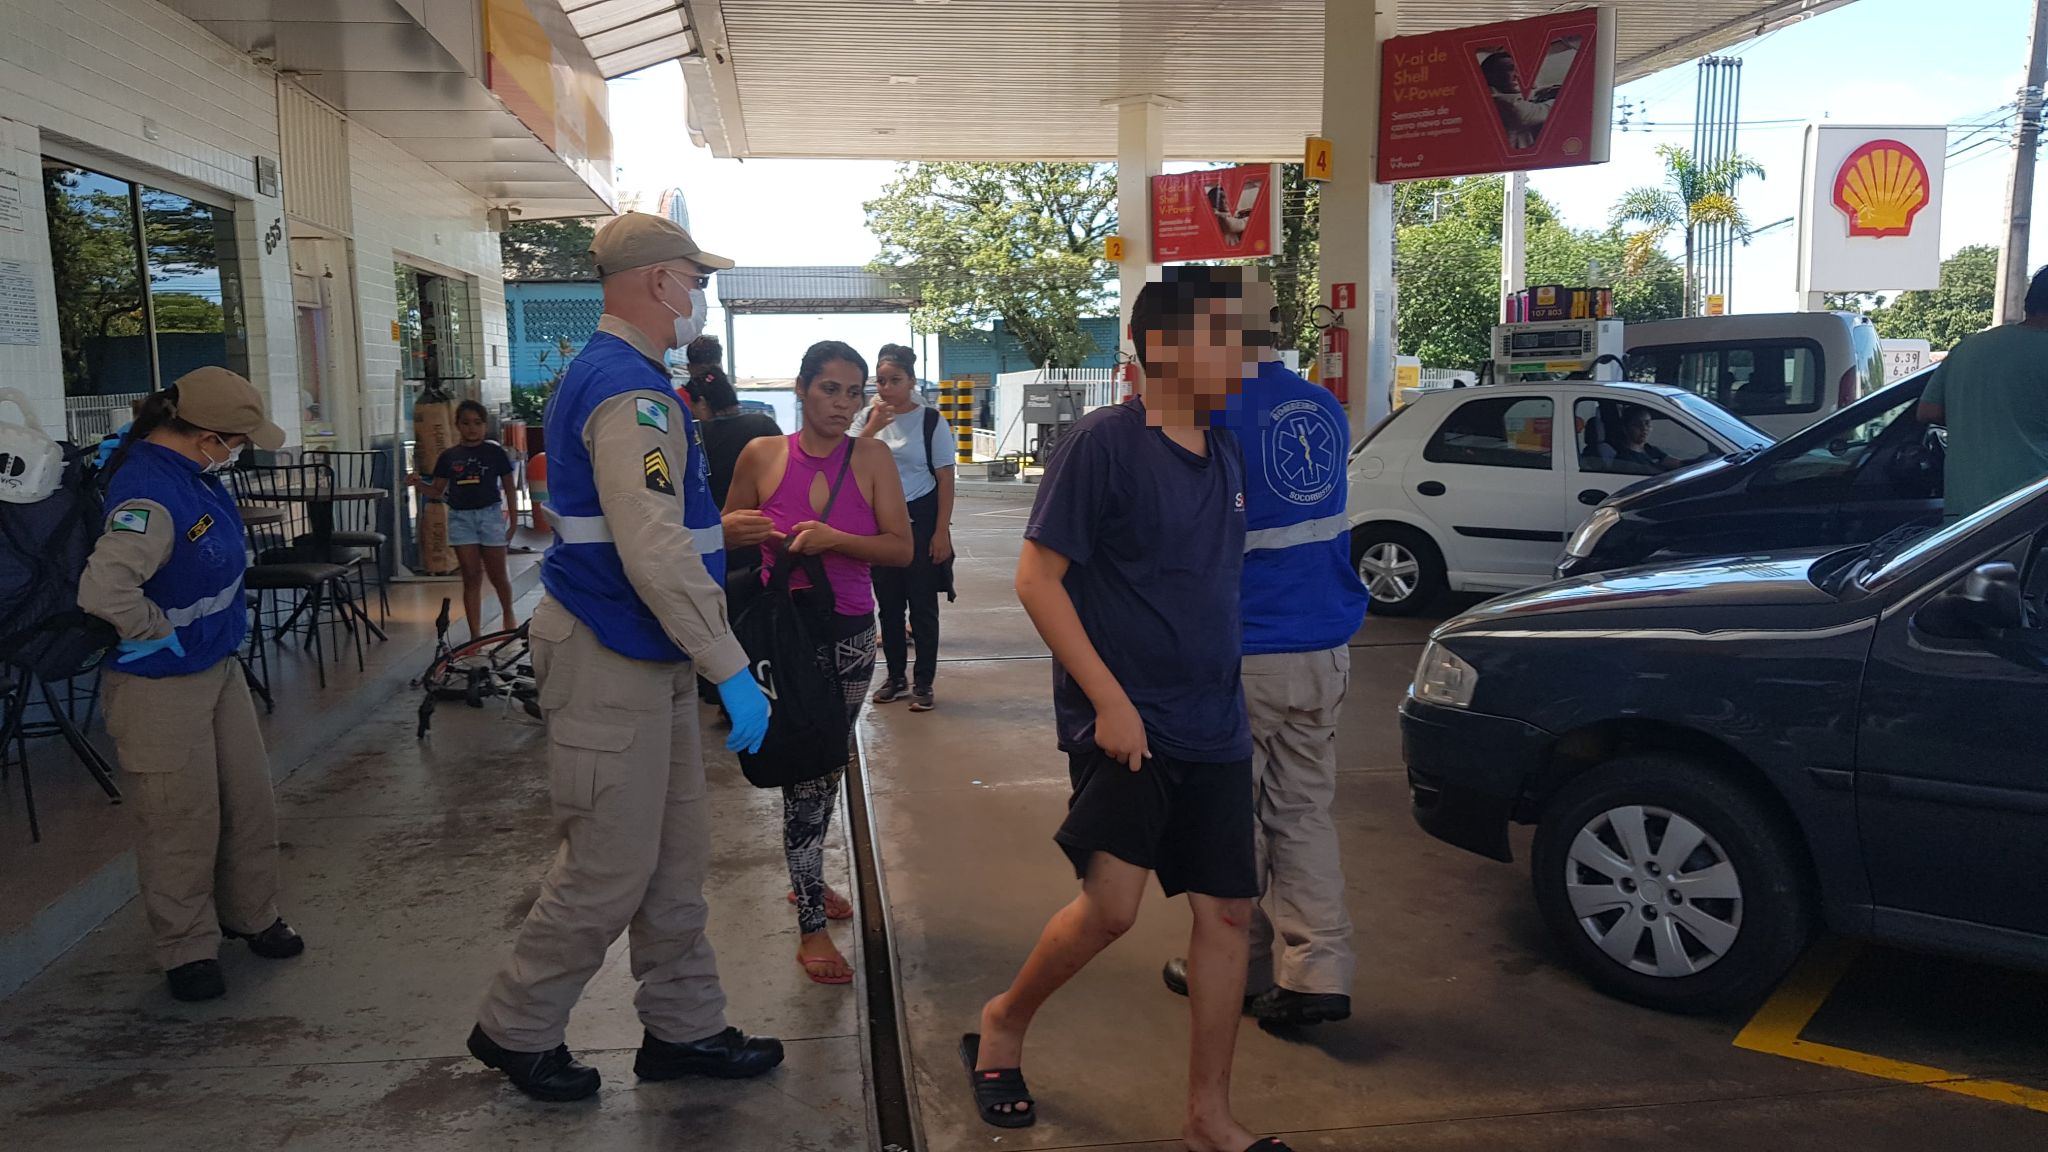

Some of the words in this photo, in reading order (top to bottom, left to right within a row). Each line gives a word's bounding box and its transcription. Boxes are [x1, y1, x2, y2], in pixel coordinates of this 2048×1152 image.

[1394, 50, 1424, 67] V-ai
[1428, 47, 1448, 64] de
[1394, 66, 1429, 86] Shell
[1393, 86, 1459, 102] V-Power
[1317, 150, 1327, 172] 4
[1114, 242, 1121, 257] 2
[1894, 353, 1917, 363] 6.39
[1288, 483, 1332, 502] SOCORRISTA
